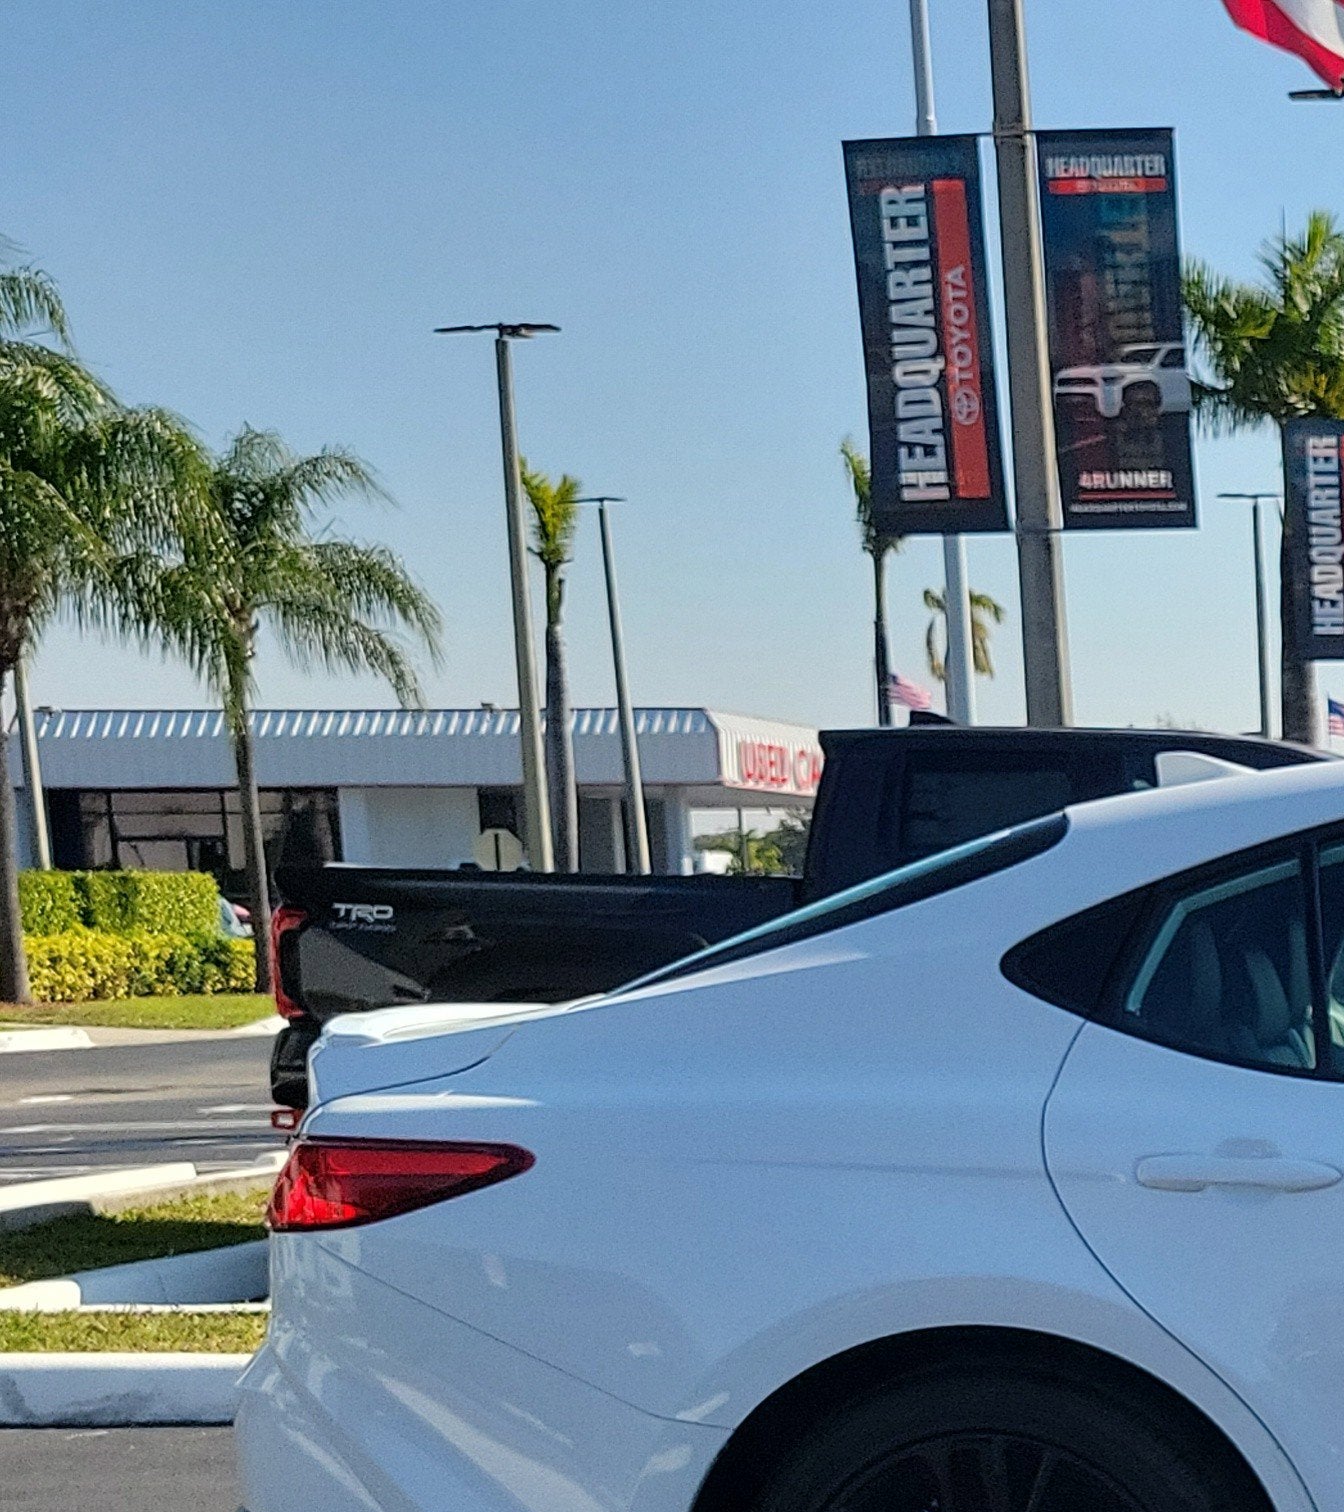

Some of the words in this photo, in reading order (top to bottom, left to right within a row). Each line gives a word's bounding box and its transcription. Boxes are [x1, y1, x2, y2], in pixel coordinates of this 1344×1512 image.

[1045, 154, 1167, 178] HEADQUARTER
[880, 183, 951, 501] HEADQUARTER
[944, 263, 976, 386] TOYOTA
[1078, 469, 1174, 489] 4RUNNER
[740, 741, 788, 783] USED
[795, 748, 823, 789] CA
[332, 902, 394, 924] TRD
